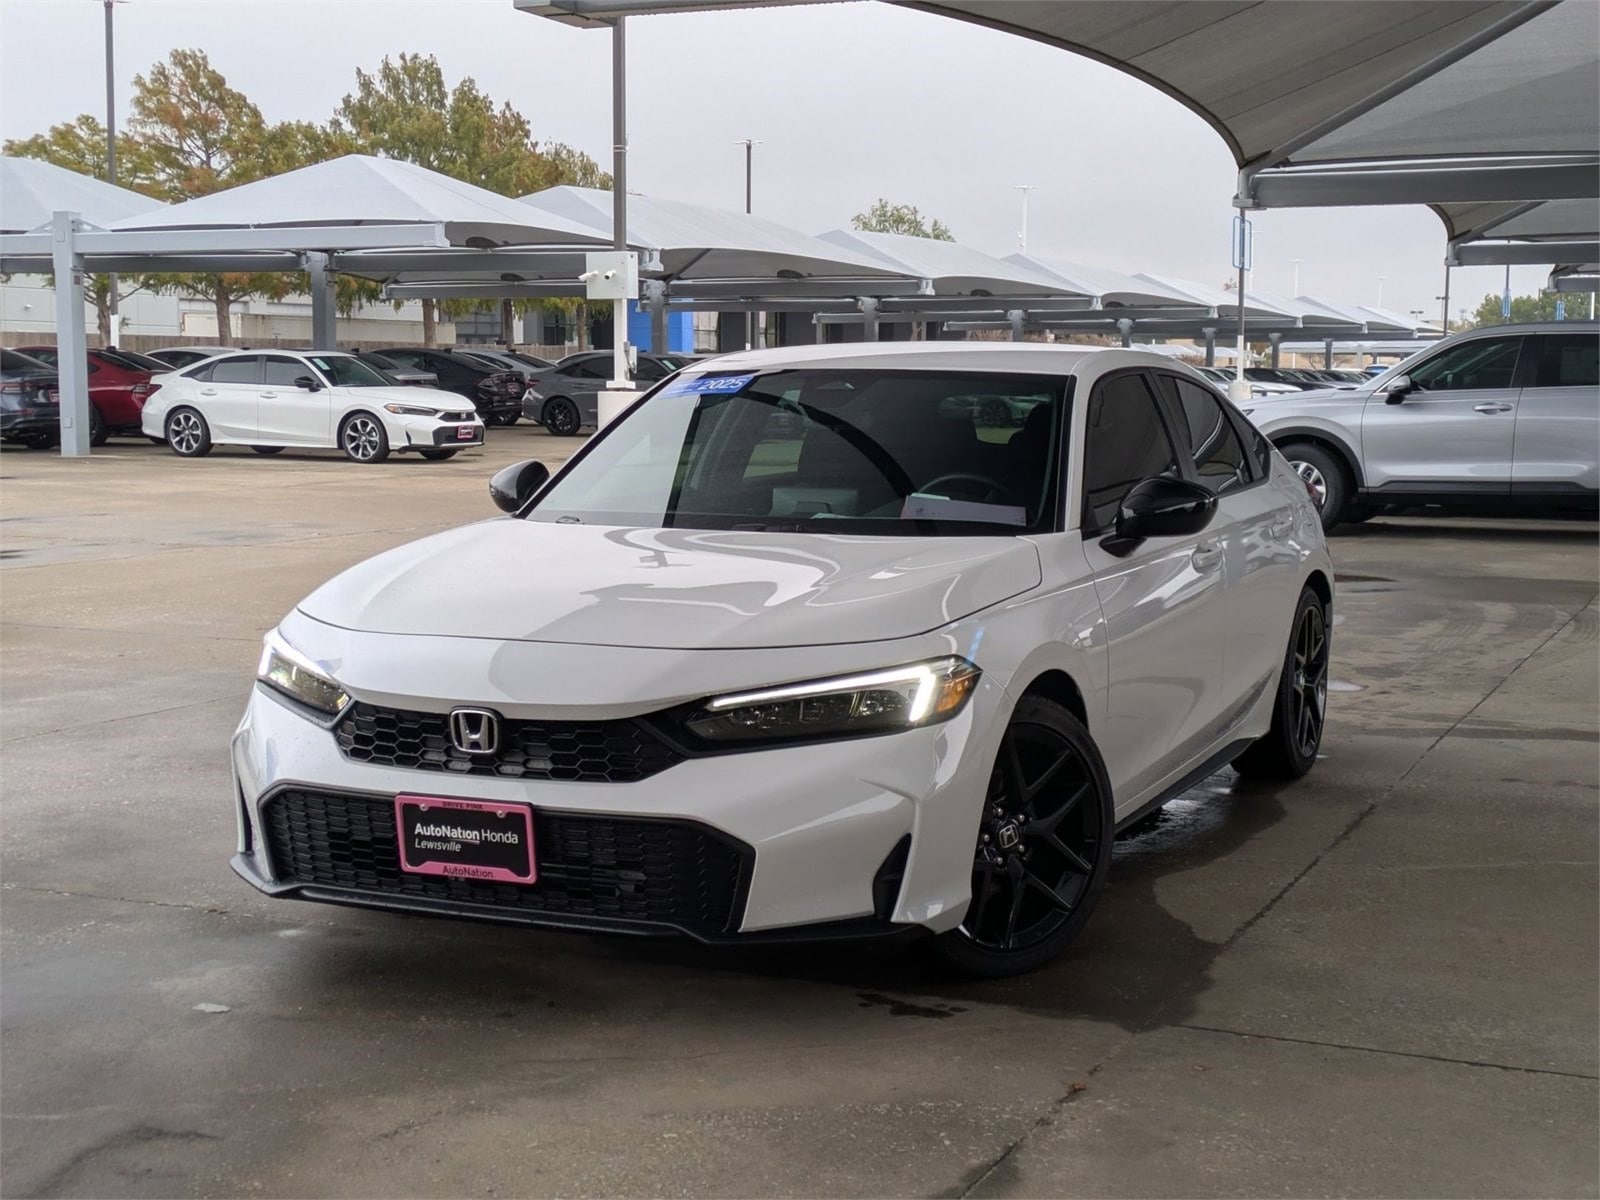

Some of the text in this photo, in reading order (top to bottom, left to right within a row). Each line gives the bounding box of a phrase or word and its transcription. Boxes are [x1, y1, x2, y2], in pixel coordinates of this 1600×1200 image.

[697, 378, 747, 390] 2025
[442, 801, 464, 809] DRIVE
[414, 823, 519, 844] AutoNation Honda
[415, 838, 461, 852] Lewisville
[442, 865, 494, 878] AutoNation
